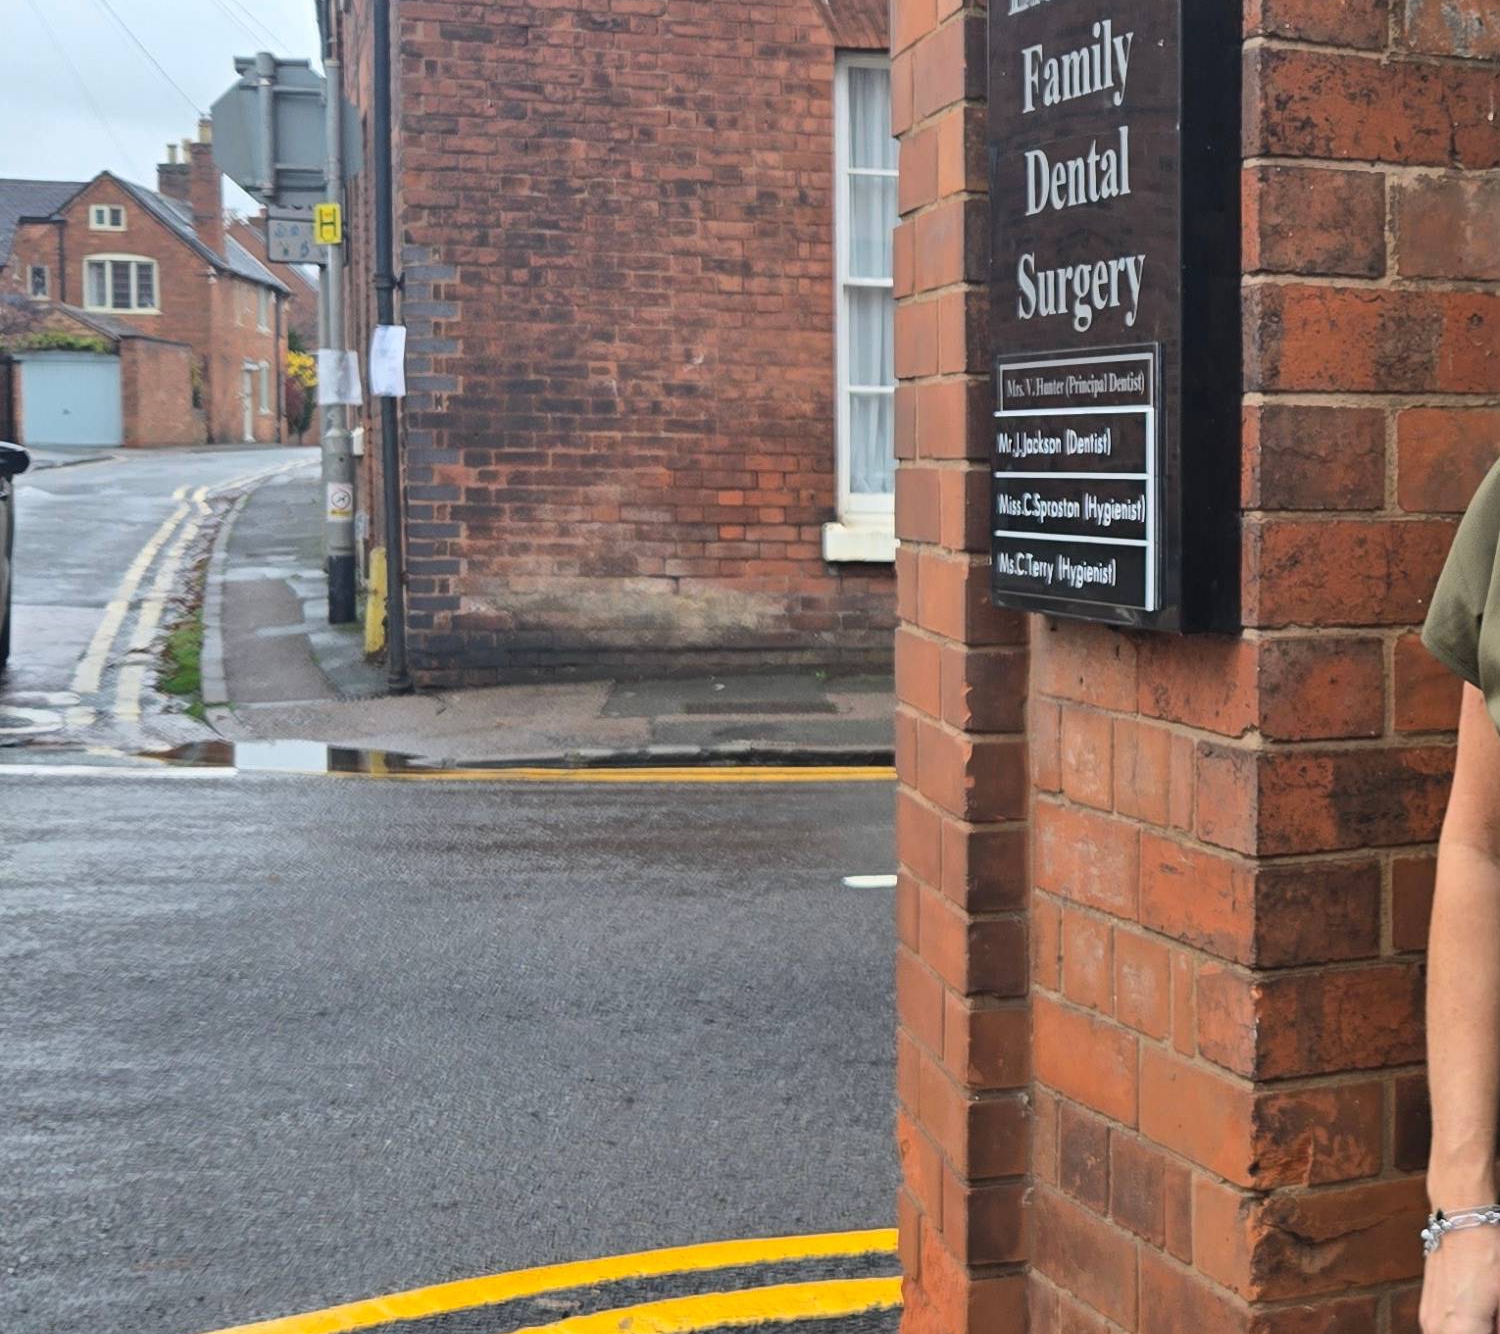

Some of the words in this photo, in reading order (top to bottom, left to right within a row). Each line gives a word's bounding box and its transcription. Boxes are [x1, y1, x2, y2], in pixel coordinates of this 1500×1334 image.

[1022, 19, 1134, 114] Family
[1025, 126, 1131, 216] Dental
[1018, 252, 1145, 332] Surgery
[1065, 373, 1107, 399] (Principal
[1108, 370, 1145, 395] Dentist)
[1066, 427, 1112, 456] (Dentist)
[1083, 492, 1146, 526] (Hygienist)
[1057, 554, 1117, 589] (Hygienist)
